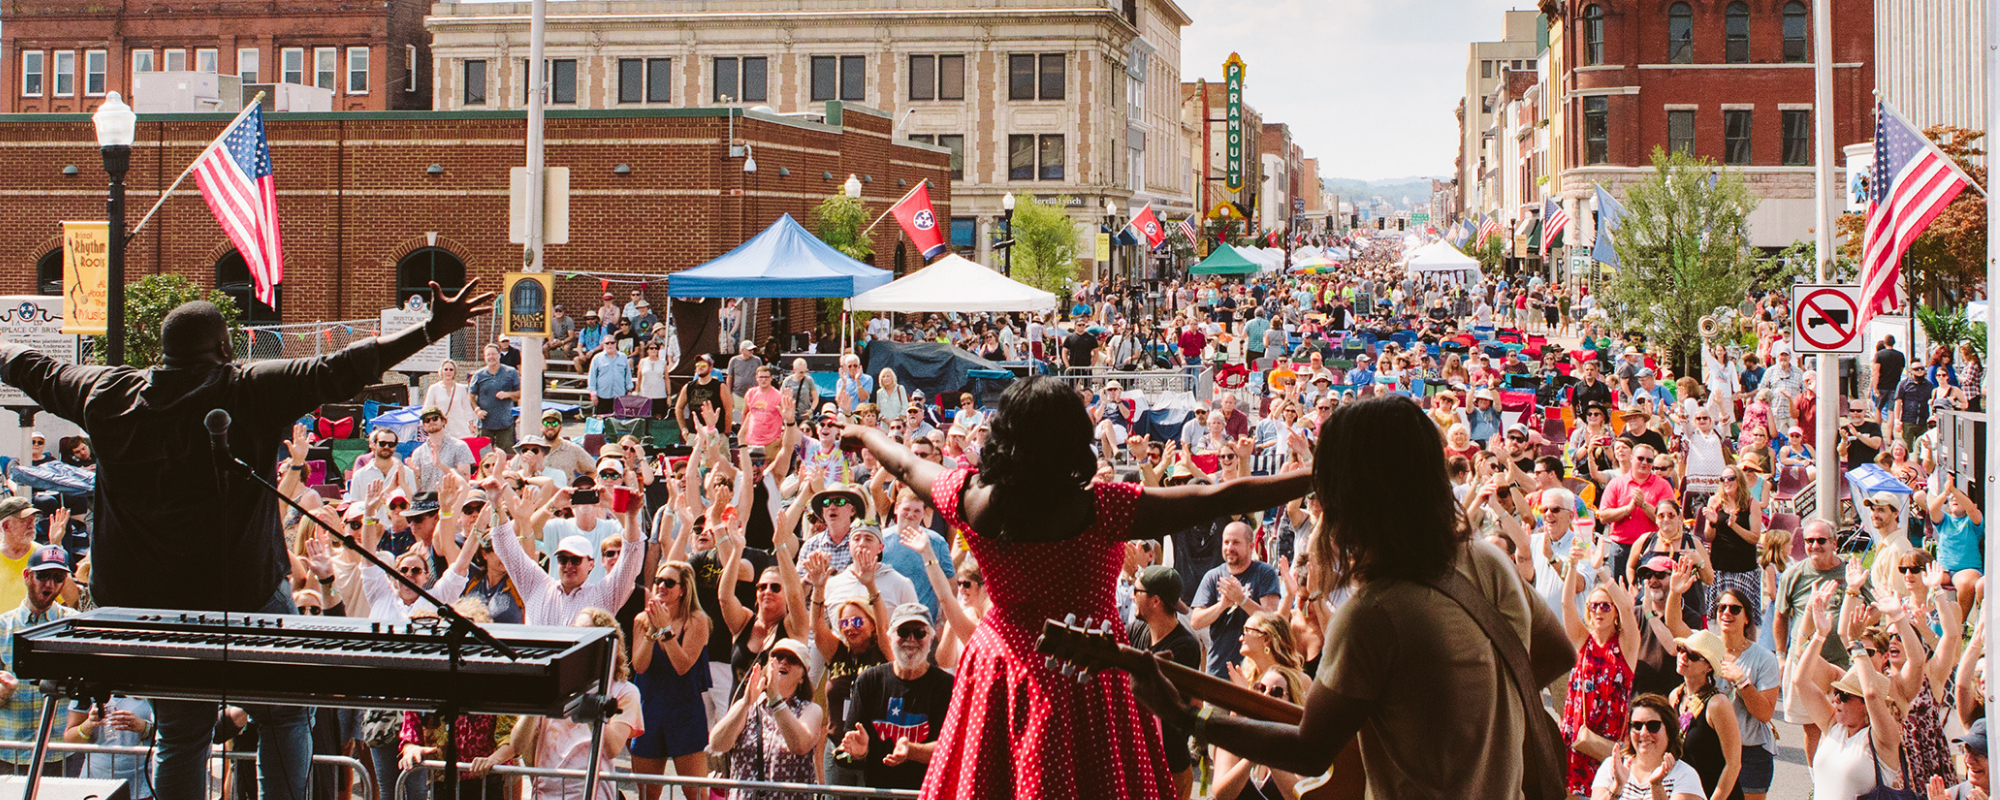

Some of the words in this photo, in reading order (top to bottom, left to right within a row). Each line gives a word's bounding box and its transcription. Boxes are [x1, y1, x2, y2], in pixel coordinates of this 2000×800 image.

[1229, 65, 1240, 185] PARAMOUNT
[75, 232, 93, 240] Bristol
[74, 240, 106, 256] Rhythm
[80, 256, 106, 267] Roots
[78, 308, 106, 321] Music
[512, 314, 535, 322] MAIN
[512, 321, 545, 331] STREET
